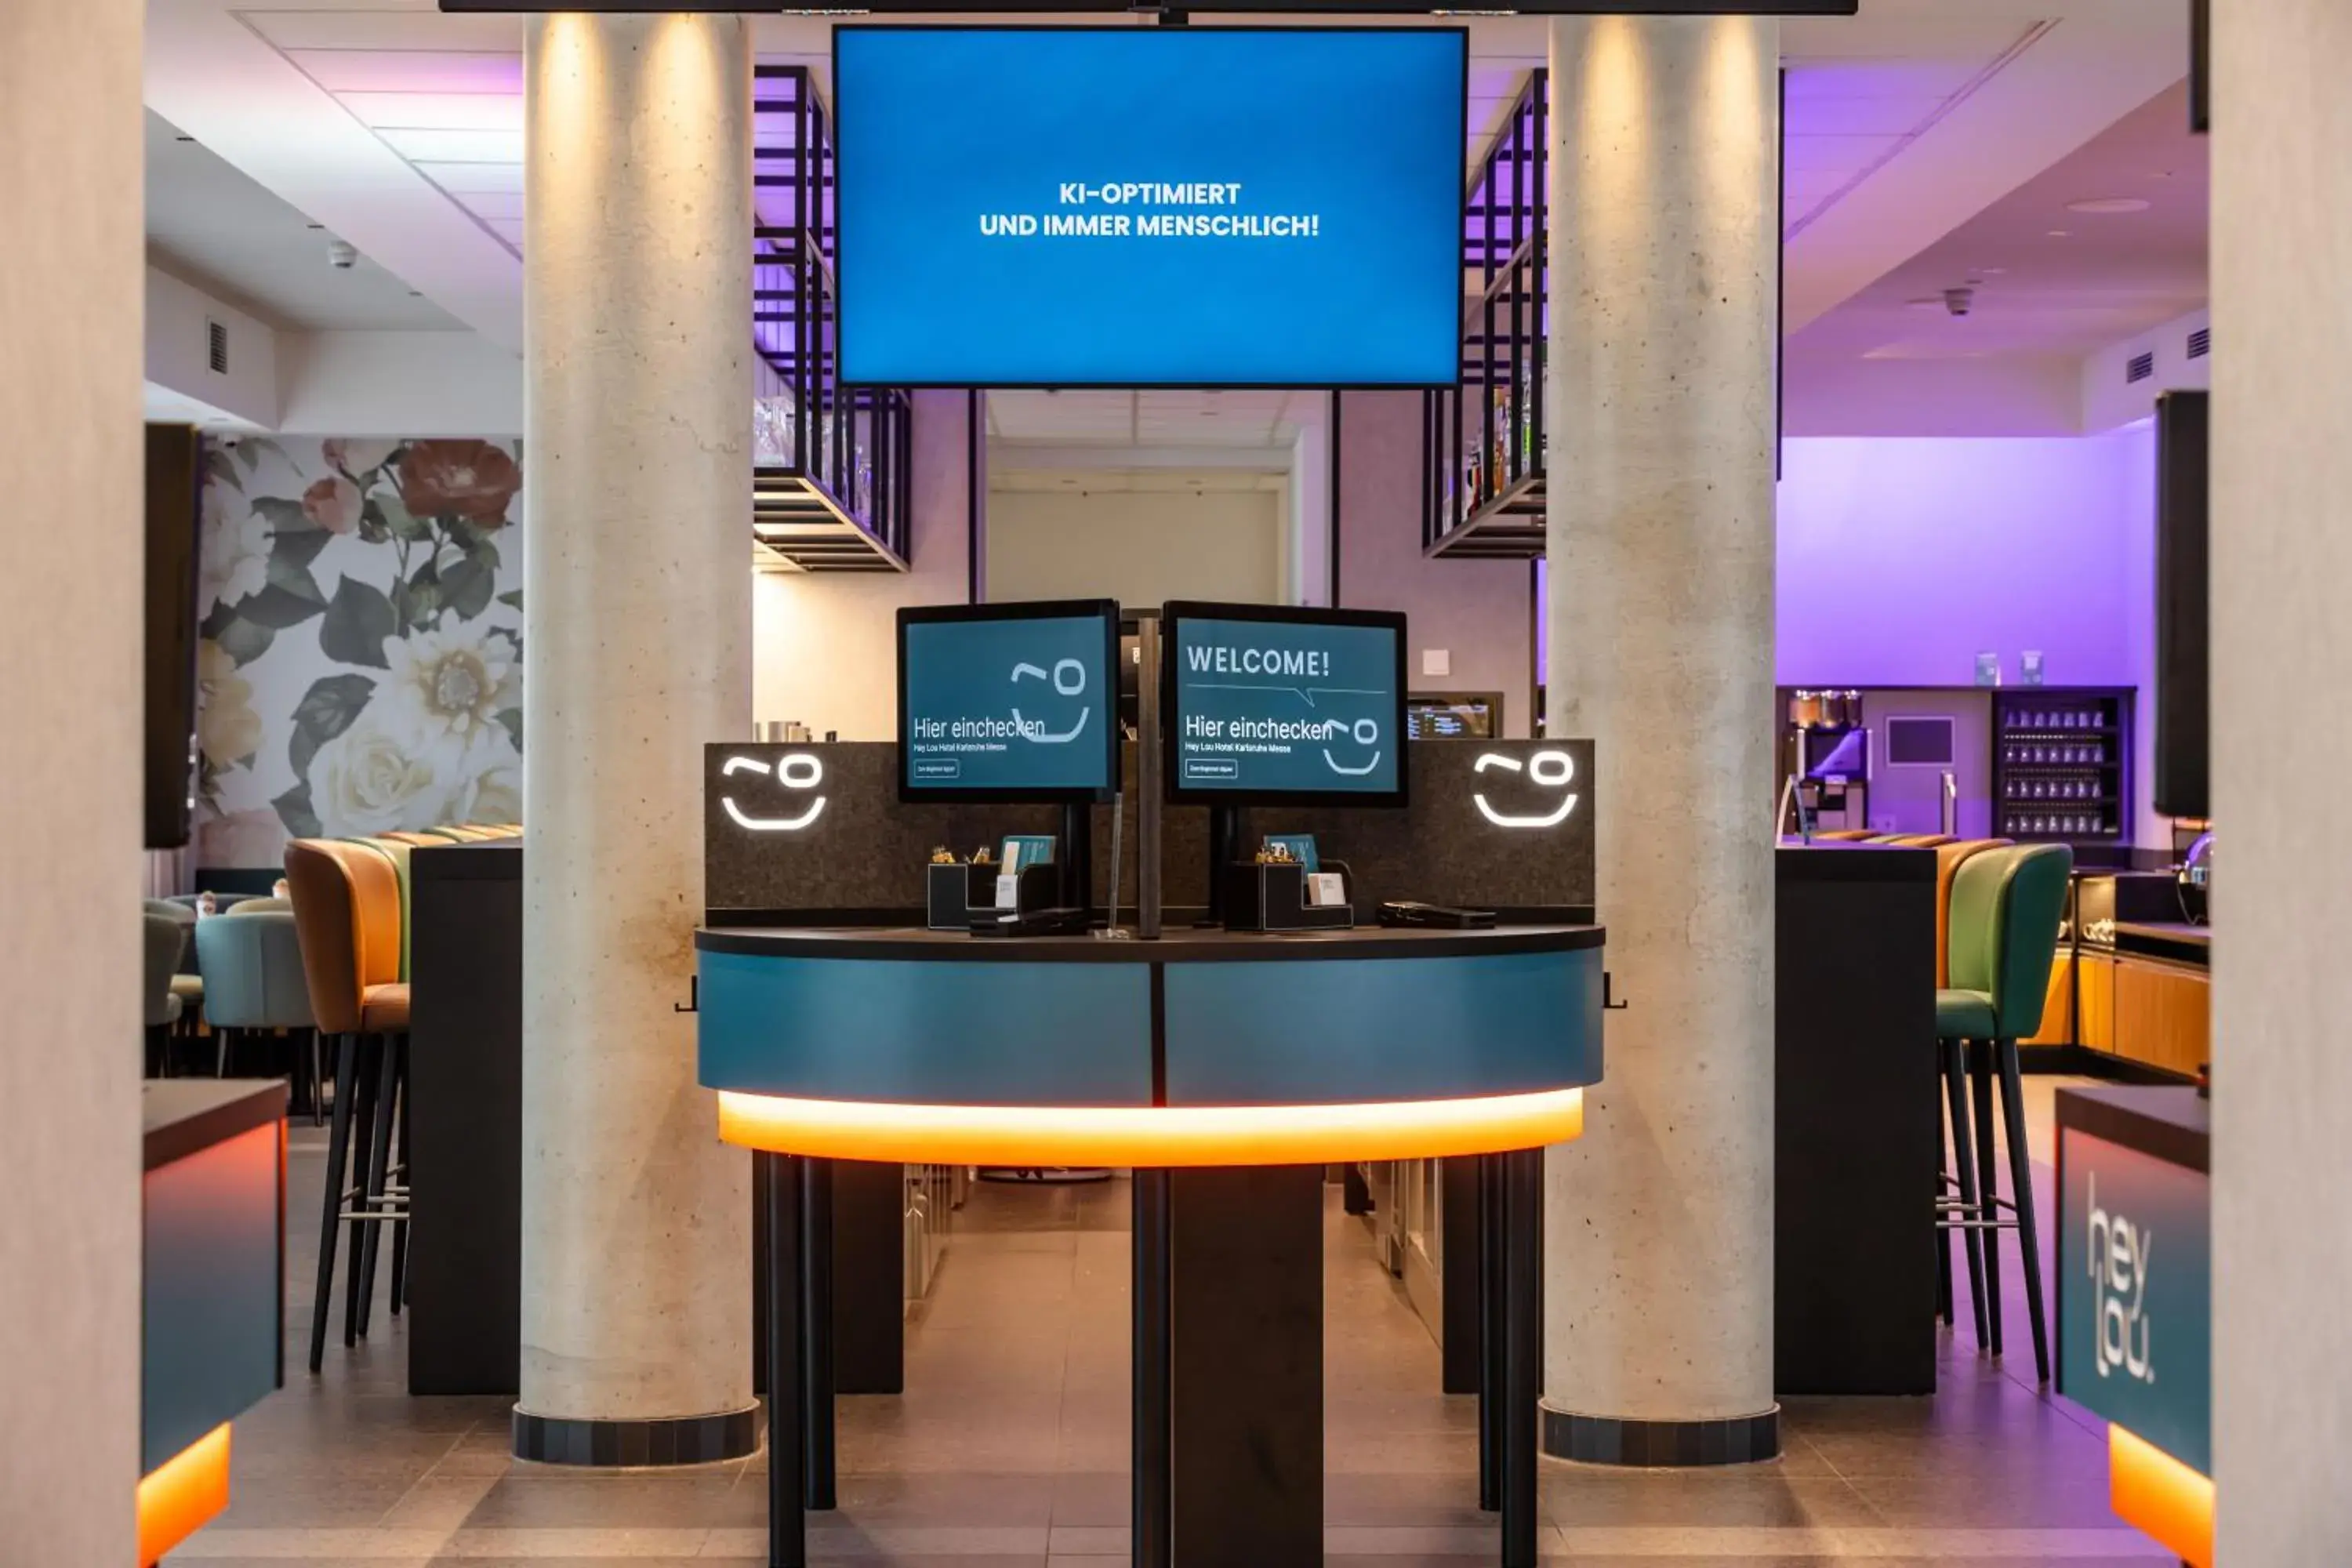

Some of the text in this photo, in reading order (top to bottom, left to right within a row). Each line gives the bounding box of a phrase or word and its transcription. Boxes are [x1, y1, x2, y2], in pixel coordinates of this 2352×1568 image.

[1059, 183, 1241, 205] KI-OPTIMIERT
[980, 215, 1319, 236] UND IMMER MENSCHLICH!
[1187, 646, 1330, 677] WELCOME!
[914, 717, 1045, 739] Hier einchecken
[1186, 715, 1333, 741] Hier einchecken
[926, 743, 938, 752] Lou
[1200, 742, 1214, 751] Lou
[1214, 742, 1234, 752] Hotel
[2087, 1169, 2151, 1323] hey
